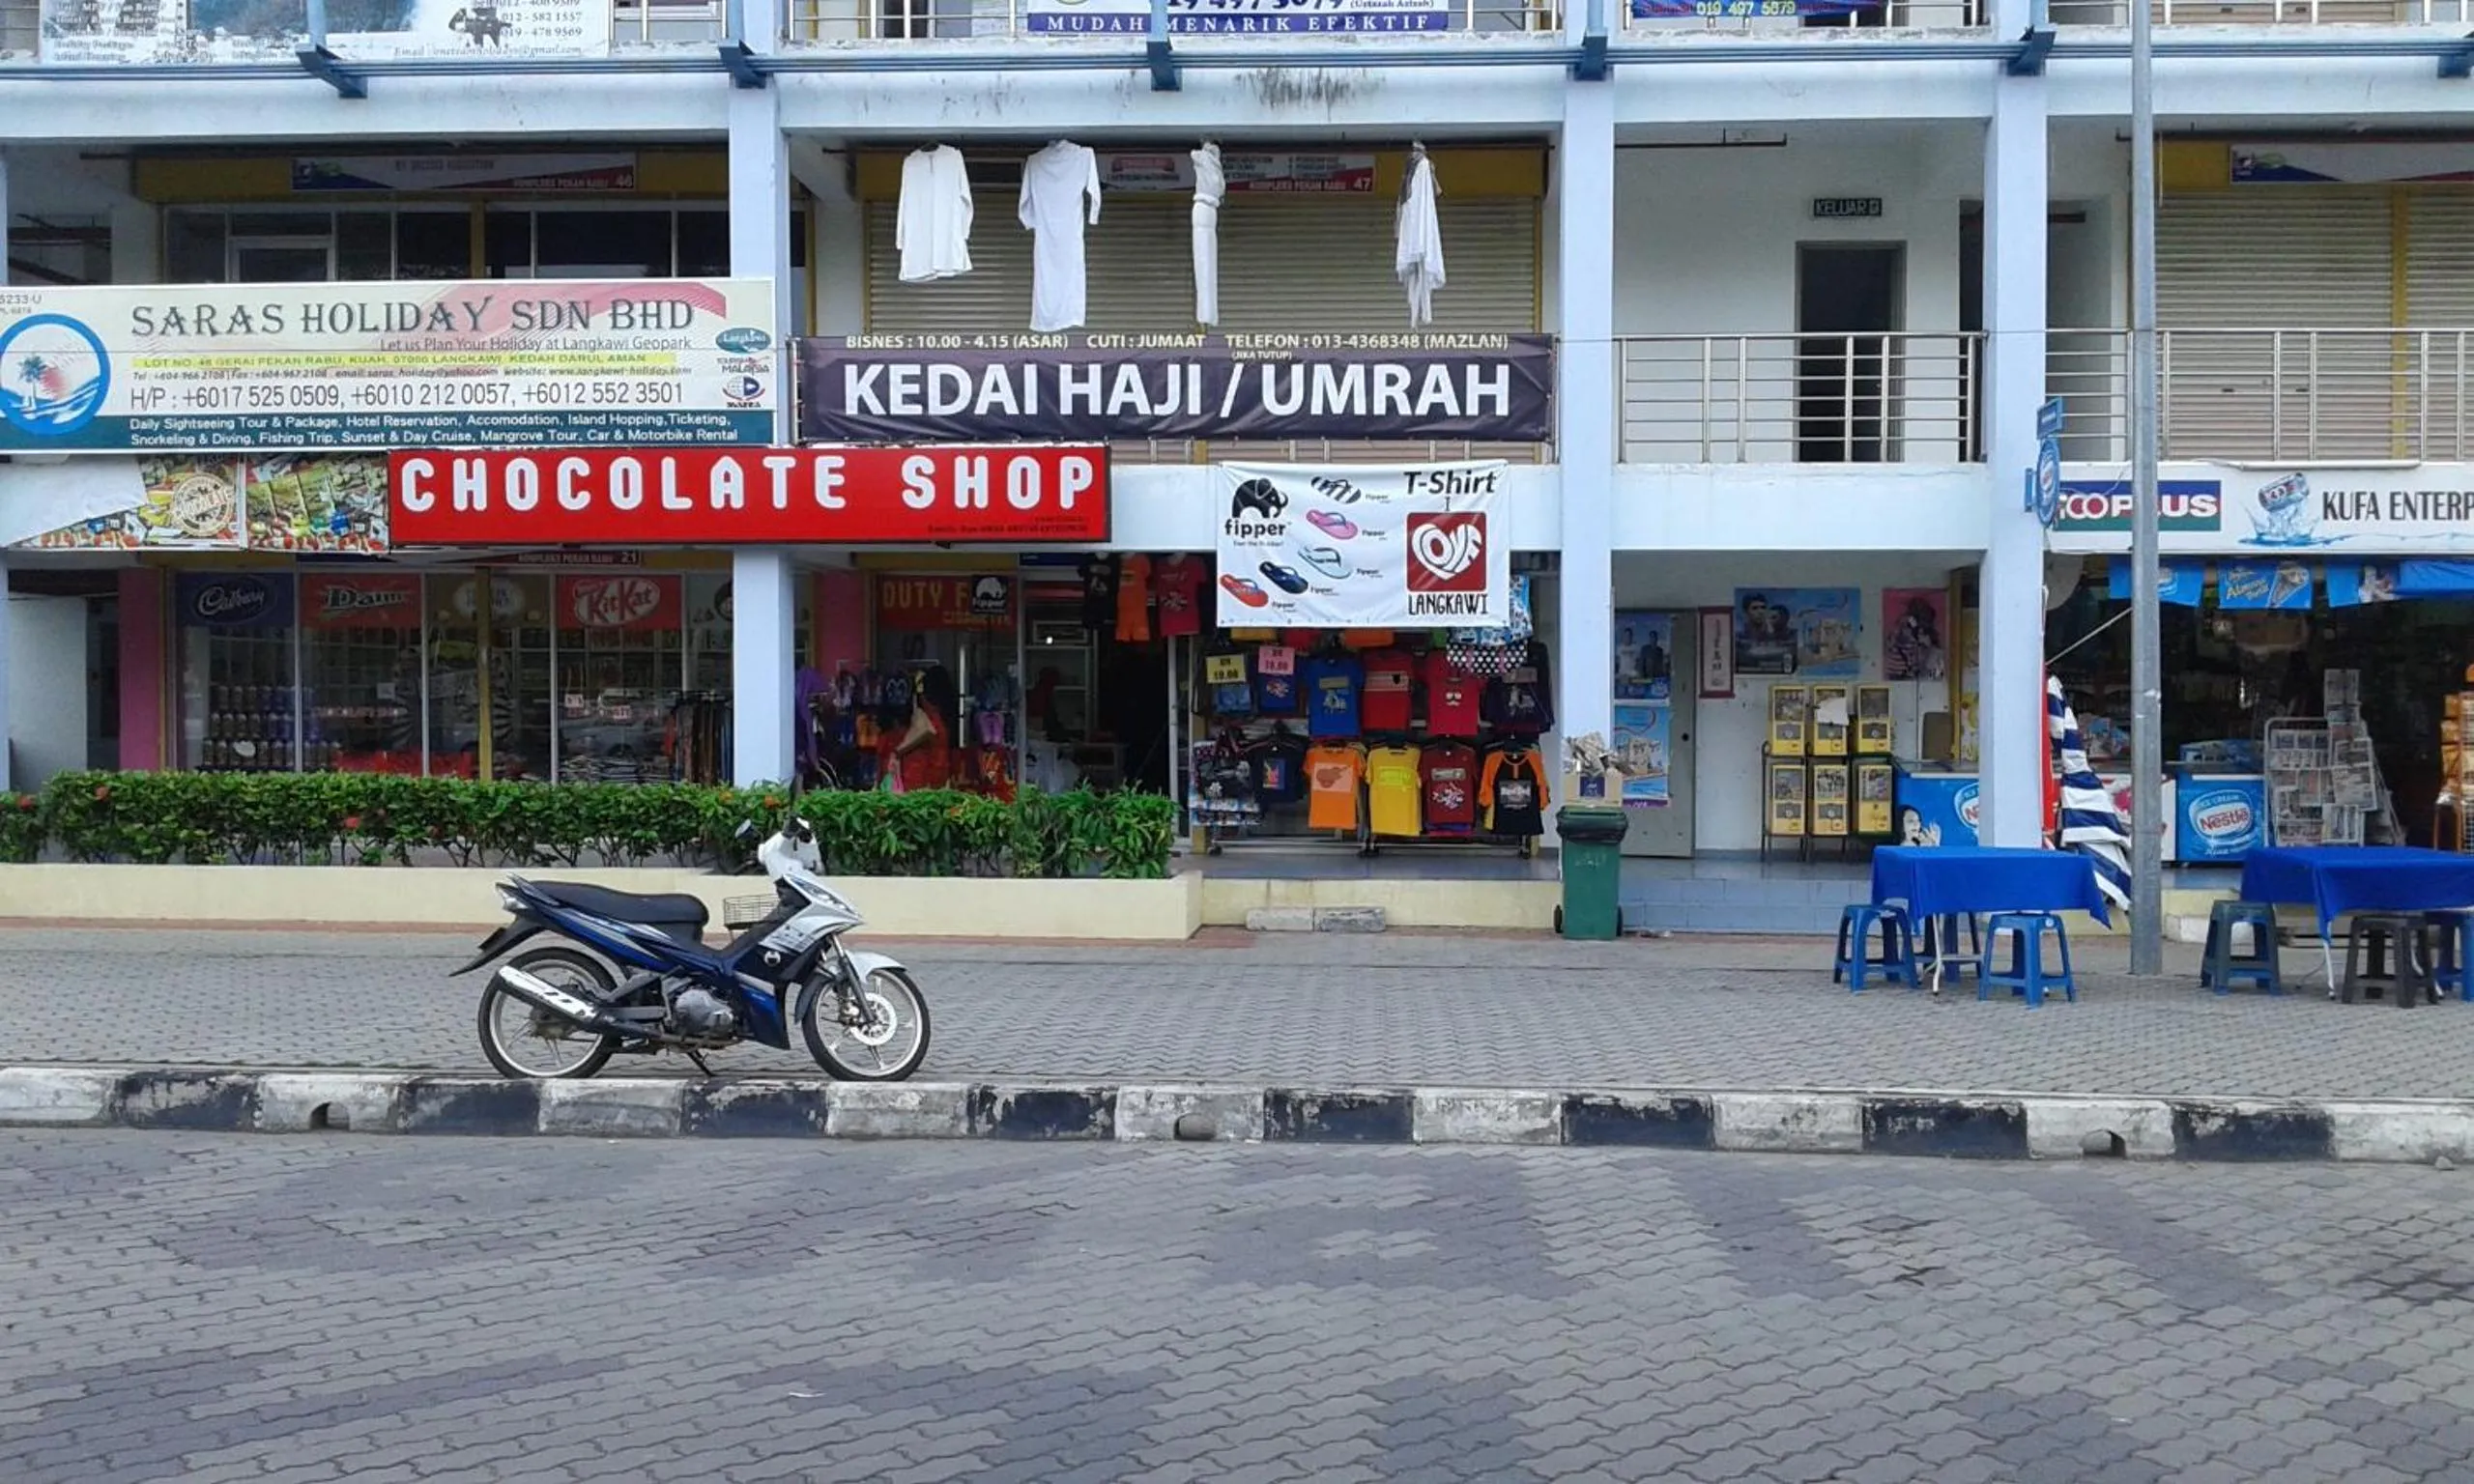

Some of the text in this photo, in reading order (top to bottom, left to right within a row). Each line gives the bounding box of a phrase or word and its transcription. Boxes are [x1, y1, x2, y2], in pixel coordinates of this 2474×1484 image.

[1047, 14, 1430, 31] MUDAH MENARIK EFEKTIF
[1353, 177, 1371, 190] 47
[131, 295, 694, 337] SARAS HOLIDAY SDN BHD
[380, 335, 692, 353] Let us Plan Your Holiday at Langkawi Geopark
[846, 335, 905, 349] BISNES
[918, 335, 962, 349] 10.00
[973, 335, 1009, 349] 4.15
[1013, 333, 1069, 350] (ASAR)
[1086, 334, 1126, 349] CUTI
[1136, 333, 1207, 349] JUMAAT
[1224, 334, 1300, 349] TELEFON
[1312, 334, 1420, 349] 013-4368348
[1424, 333, 1510, 350] (MAZLAN)
[508, 355, 556, 363] KEDAH
[559, 354, 605, 363] DARUL
[607, 354, 647, 362] AMAN
[129, 386, 166, 410] H/P
[182, 385, 243, 409] +6017
[248, 385, 285, 407] 525
[351, 384, 415, 407] +6010
[418, 383, 455, 406] 212
[522, 382, 586, 405] +6012
[592, 381, 629, 404] 552
[635, 381, 682, 404] 3501
[843, 362, 1038, 416] KEDAI
[1058, 362, 1202, 416] HAJI
[1260, 362, 1510, 416] UMRAH
[129, 417, 159, 431] Daily
[162, 417, 235, 431] Sightseeing
[240, 416, 268, 428] Tour
[272, 416, 281, 427] &
[346, 414, 380, 427] Hotel
[568, 414, 606, 426] Island
[130, 434, 195, 446] Snorkeling
[199, 434, 209, 445] &
[259, 433, 304, 446] Fishing
[341, 431, 386, 443] Sunset
[389, 431, 399, 442] &
[403, 431, 428, 444] Day
[480, 430, 543, 444] Mangrove
[587, 429, 609, 442] Car
[614, 429, 623, 441] &
[628, 428, 693, 442] Motorbike
[697, 428, 738, 441] Rental
[400, 455, 1094, 512] CHOCOLATE SHOP
[1403, 470, 1498, 495] T-Shirt
[2321, 491, 2380, 521] KUFA
[1224, 519, 1287, 538] fipper
[198, 585, 266, 616] Cadbury
[587, 580, 655, 624] KitKat
[882, 581, 943, 609] DUTY
[1408, 592, 1489, 615] LANGKAWI
